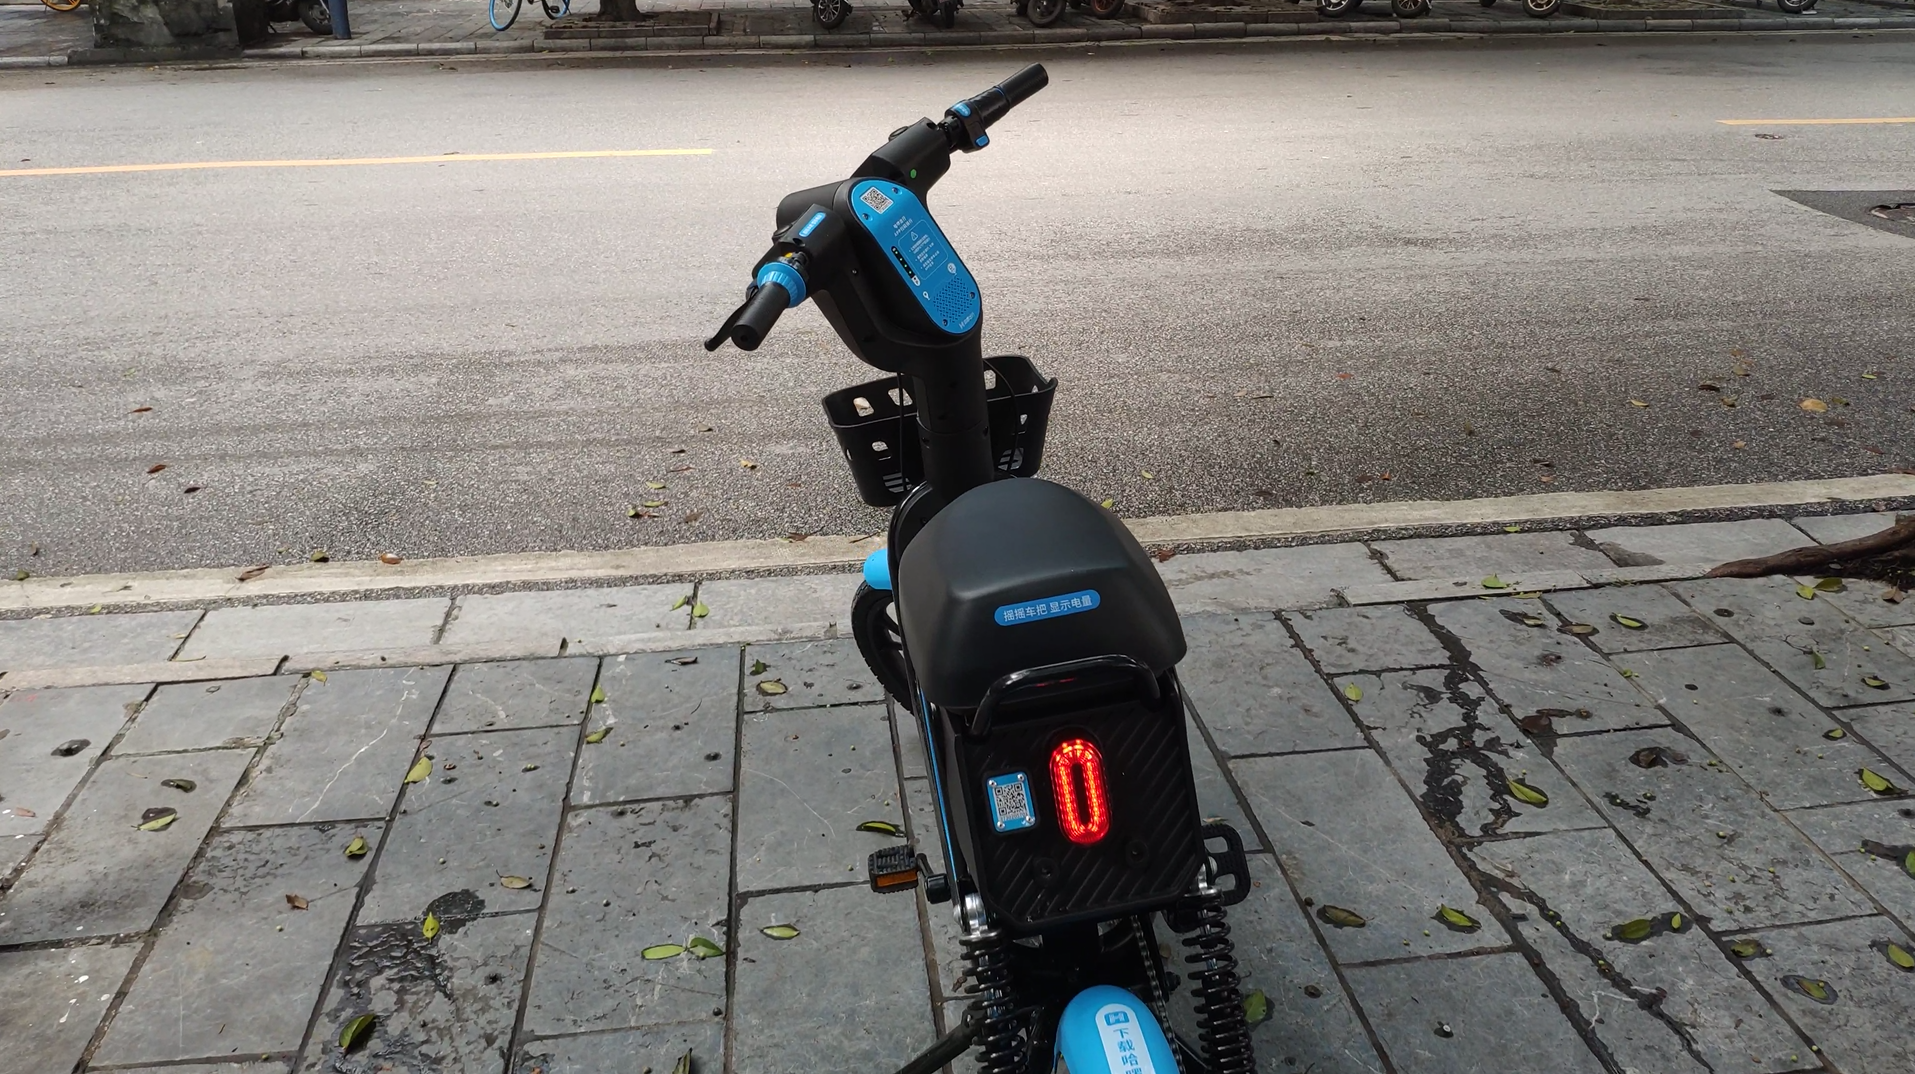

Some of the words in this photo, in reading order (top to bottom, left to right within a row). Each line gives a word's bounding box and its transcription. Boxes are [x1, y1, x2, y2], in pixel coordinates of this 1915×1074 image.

[1003, 604, 1048, 622] 摇摇车把
[1049, 594, 1093, 613] 显示电量
